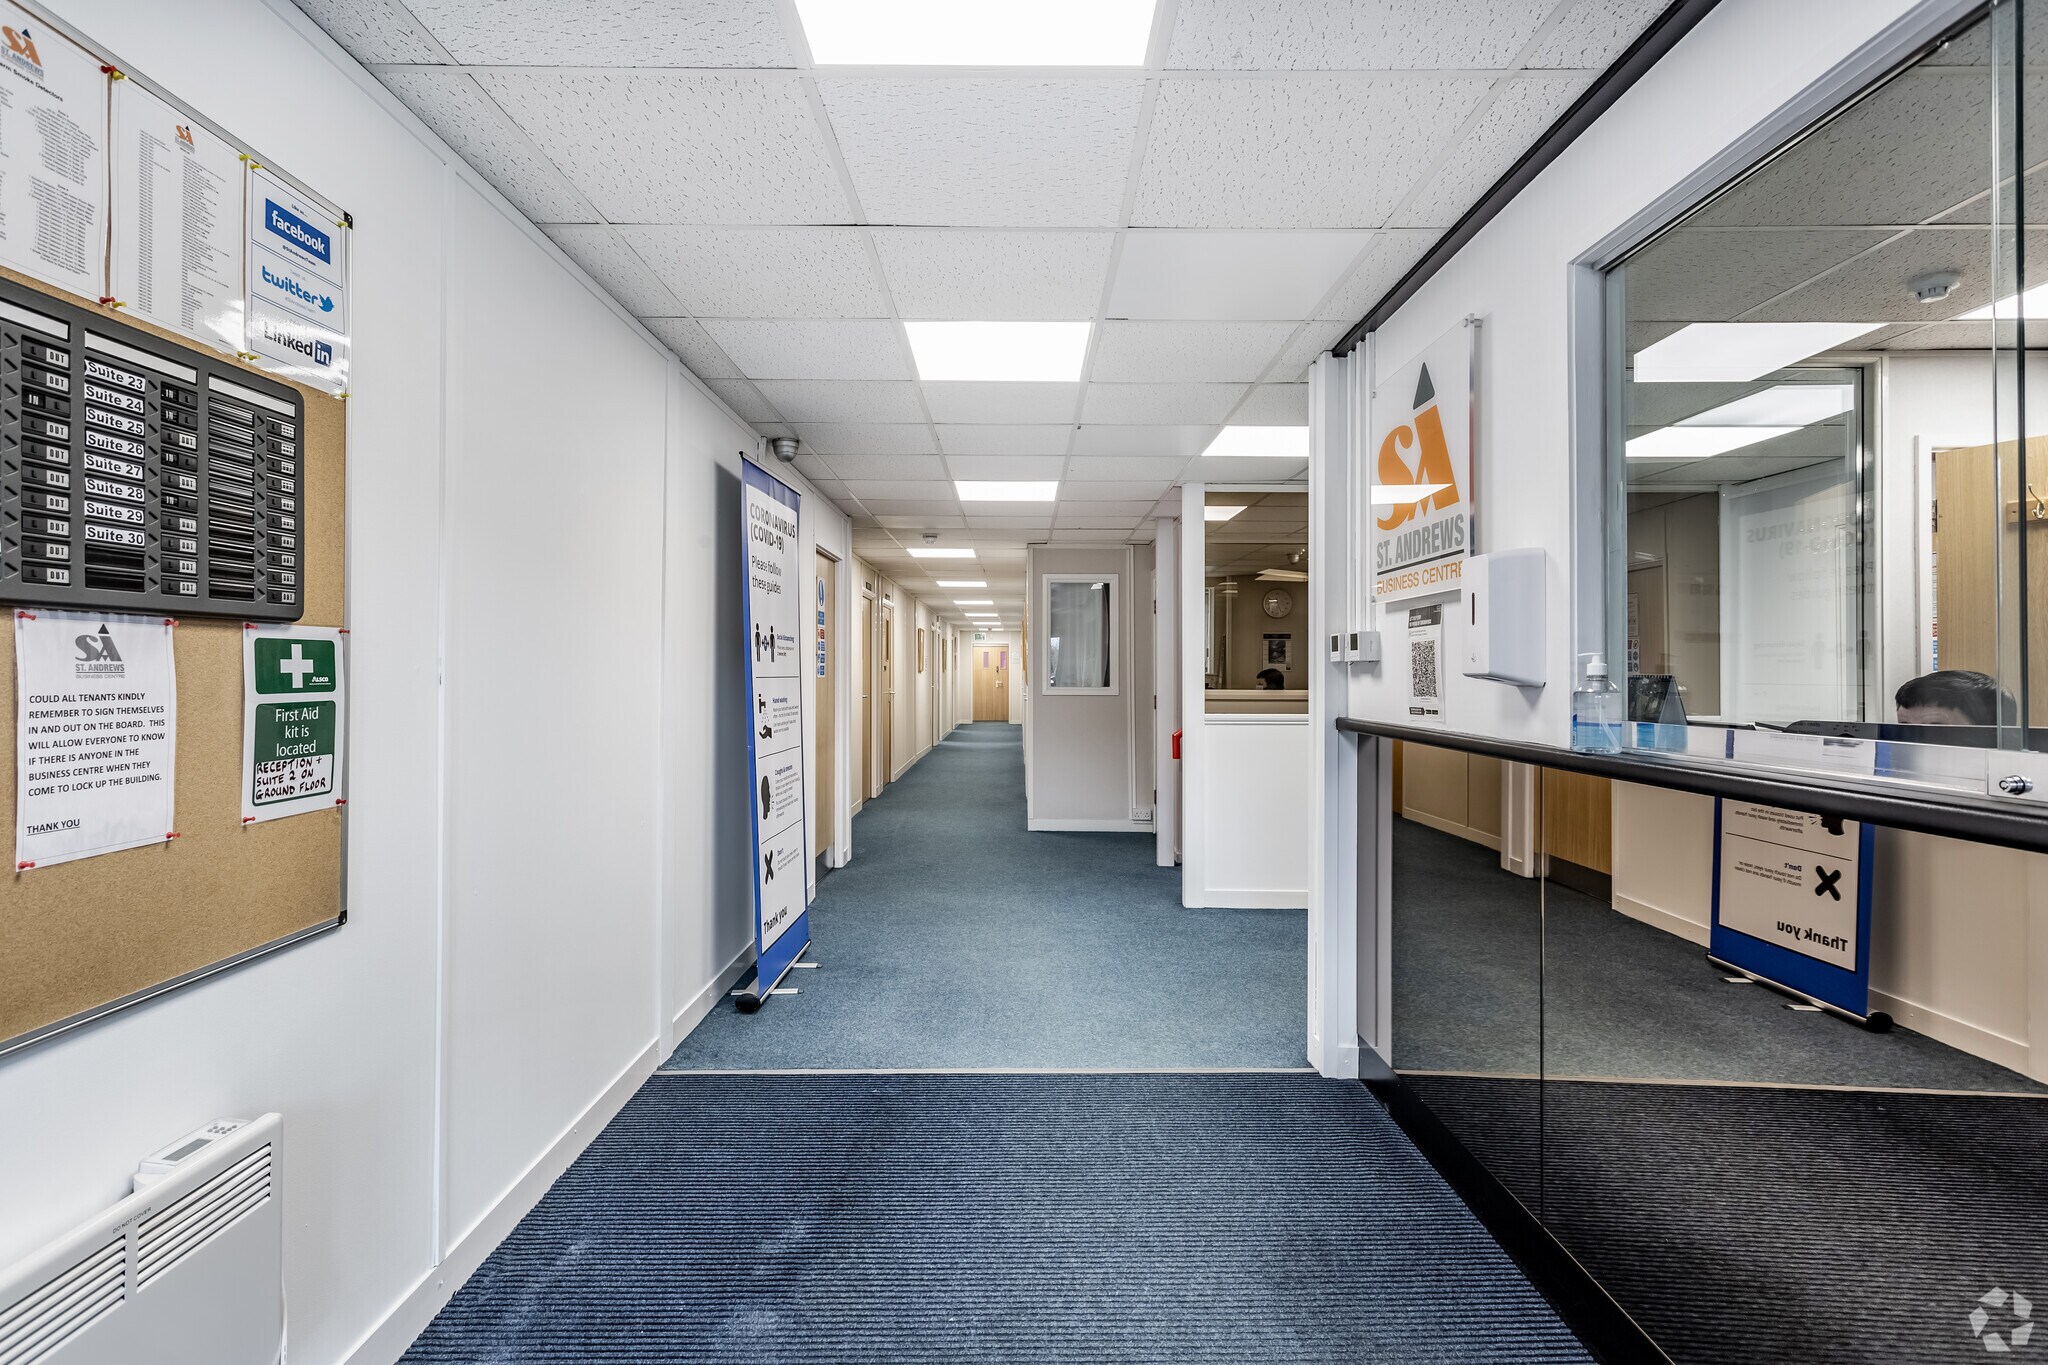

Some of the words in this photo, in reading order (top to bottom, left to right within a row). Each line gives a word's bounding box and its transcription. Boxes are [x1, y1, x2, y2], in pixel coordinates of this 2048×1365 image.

[35, 82, 63, 102] Detectors
[272, 210, 325, 254] facebook
[262, 266, 318, 304] twitter
[50, 351, 64, 364] OUT
[50, 376, 64, 387] OUT
[88, 361, 124, 382] Suite
[128, 376, 143, 390] 23
[29, 394, 39, 405] IN
[86, 386, 122, 405] Suite
[126, 399, 142, 412] 24
[50, 424, 64, 436] OUT
[87, 409, 123, 428] Suite
[127, 421, 143, 434] 25
[88, 434, 123, 451] Suite
[127, 443, 143, 455] 26
[50, 449, 64, 460] OUT
[86, 455, 122, 472] Suite
[126, 464, 141, 476] 27
[50, 473, 65, 484] OUT
[87, 479, 123, 495] Suite
[127, 487, 143, 499] 28
[50, 497, 64, 508] OUT
[86, 503, 123, 518] Suite
[127, 510, 142, 522] 29
[750, 503, 796, 539] CORONAVIRUS
[50, 522, 64, 532] OUT
[87, 527, 123, 542] Suite
[128, 533, 143, 545] 30
[751, 522, 784, 554] (COVID-19)
[1377, 542, 1392, 570] ST.
[1395, 513, 1465, 562] ANDREWS
[50, 546, 64, 556] OUT
[50, 571, 65, 580] OUT
[1377, 571, 1420, 595] BUSINESS
[76, 664, 86, 672] ST.
[88, 664, 125, 672] ANDREWS
[29, 695, 60, 704] COULD
[62, 694, 77, 703] ALL
[79, 694, 116, 702] TENANTS
[118, 693, 146, 701] KINDLY
[29, 709, 80, 719] REMEMBER
[82, 708, 93, 716] TO
[95, 708, 114, 716] SIGN
[116, 706, 164, 715] THEMSELVES
[276, 708, 298, 722] First
[301, 706, 318, 720] Aid
[28, 726, 38, 734] IN
[41, 725, 61, 734] AND
[63, 724, 82, 732] OUT
[84, 723, 96, 731] ON
[99, 722, 114, 730] THE
[116, 720, 146, 729] BOARD.
[150, 719, 166, 728] THIS
[285, 725, 298, 739] kit
[301, 724, 310, 738] is
[28, 741, 50, 750] WILL
[52, 738, 83, 748] ALLOW
[85, 736, 127, 746] EVERYONE
[129, 734, 140, 742] TO
[141, 732, 166, 742] KNOW
[276, 740, 316, 757] located
[28, 757, 36, 766] IF
[38, 754, 66, 765] THERE
[68, 753, 76, 762] IS
[78, 751, 112, 761] ANYONE
[125, 748, 140, 756] THE
[256, 756, 312, 774] RECEPTION
[29, 770, 70, 782] BUSINESS
[73, 766, 104, 776] CENTRE
[106, 764, 130, 774] WHEN
[132, 761, 150, 770] THEY
[256, 773, 284, 787] SUITE
[289, 771, 296, 780] 2
[301, 769, 314, 778] ON
[28, 786, 55, 797] COME
[58, 784, 70, 793] TO
[72, 781, 94, 791] LOCK
[96, 780, 107, 788] UP
[109, 778, 124, 786] THE
[126, 774, 162, 784] BUILDING.
[256, 784, 296, 800] GROUND
[299, 778, 326, 793] FLOOR
[27, 823, 59, 834] THANK
[61, 818, 80, 829] YOU
[764, 913, 778, 935] Thank
[779, 906, 788, 924] you
[112, 1226, 121, 1234] DO
[122, 1218, 132, 1228] NOT
[134, 1206, 152, 1221] COVER
